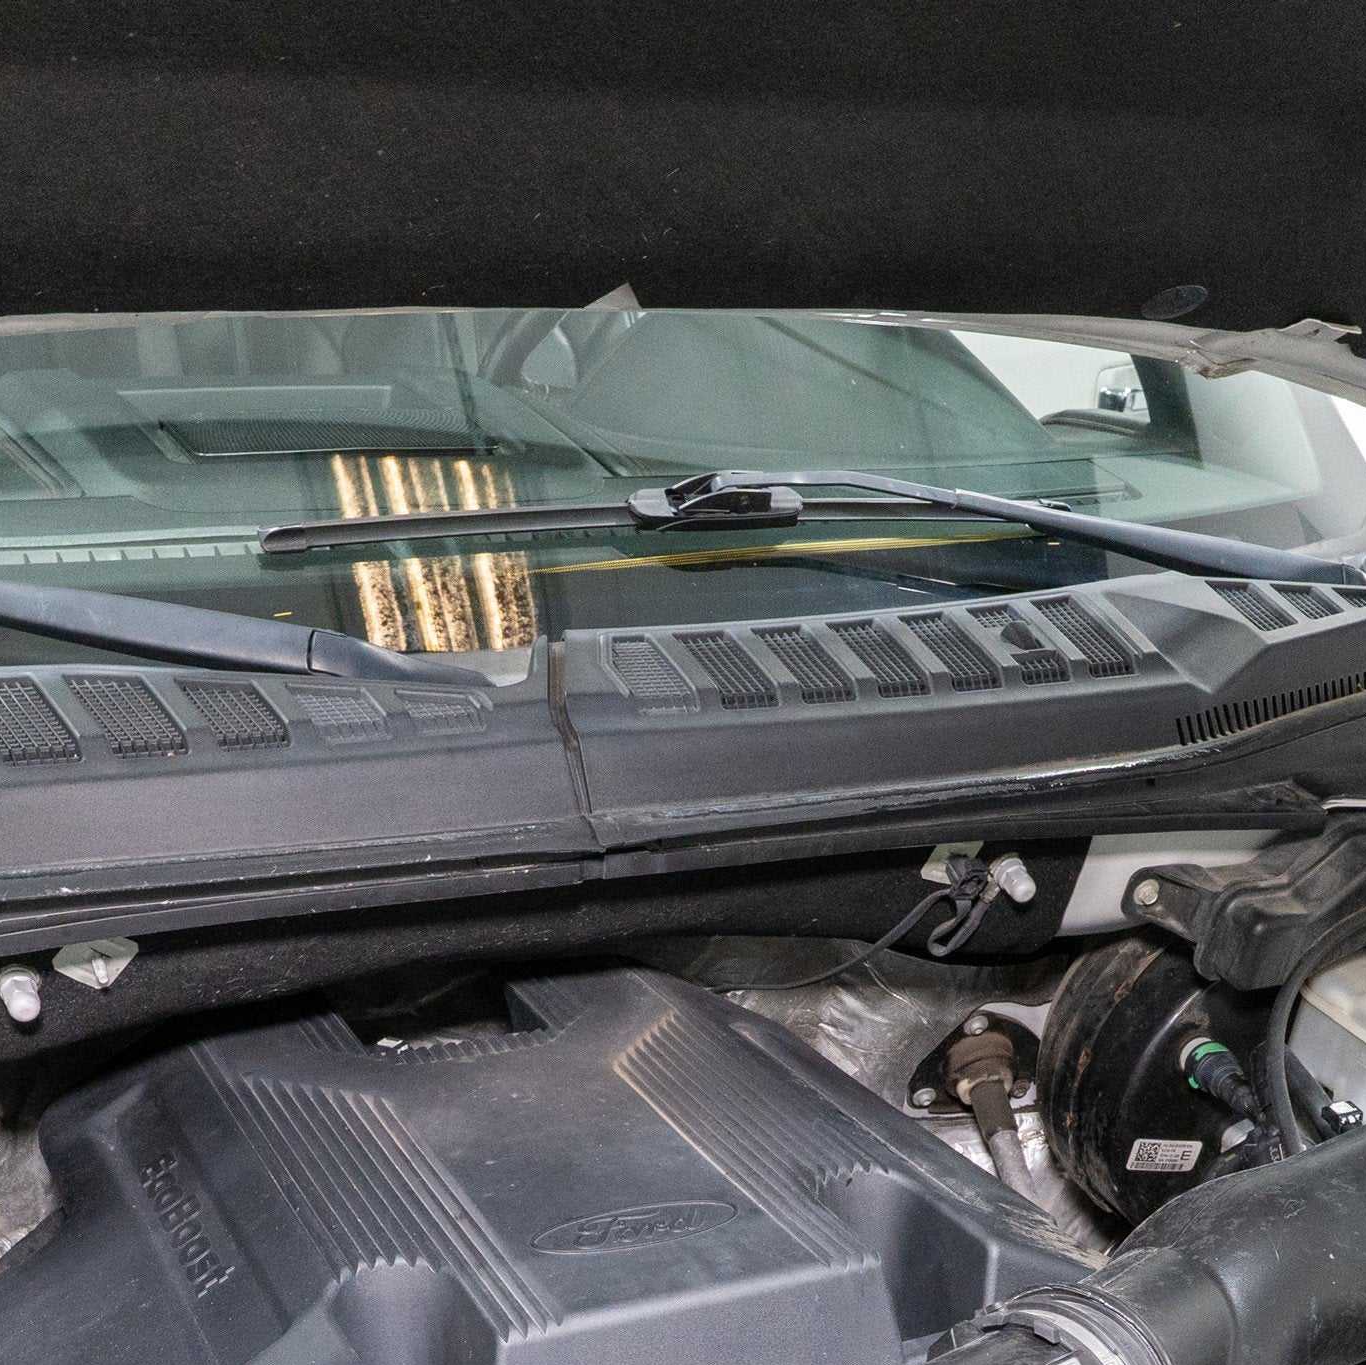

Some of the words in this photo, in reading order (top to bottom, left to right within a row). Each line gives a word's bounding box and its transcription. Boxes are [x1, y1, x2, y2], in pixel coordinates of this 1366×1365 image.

[1180, 1150, 1192, 1161] E
[138, 1155, 235, 1299] EcoBoost
[572, 1209, 705, 1250] Ford
